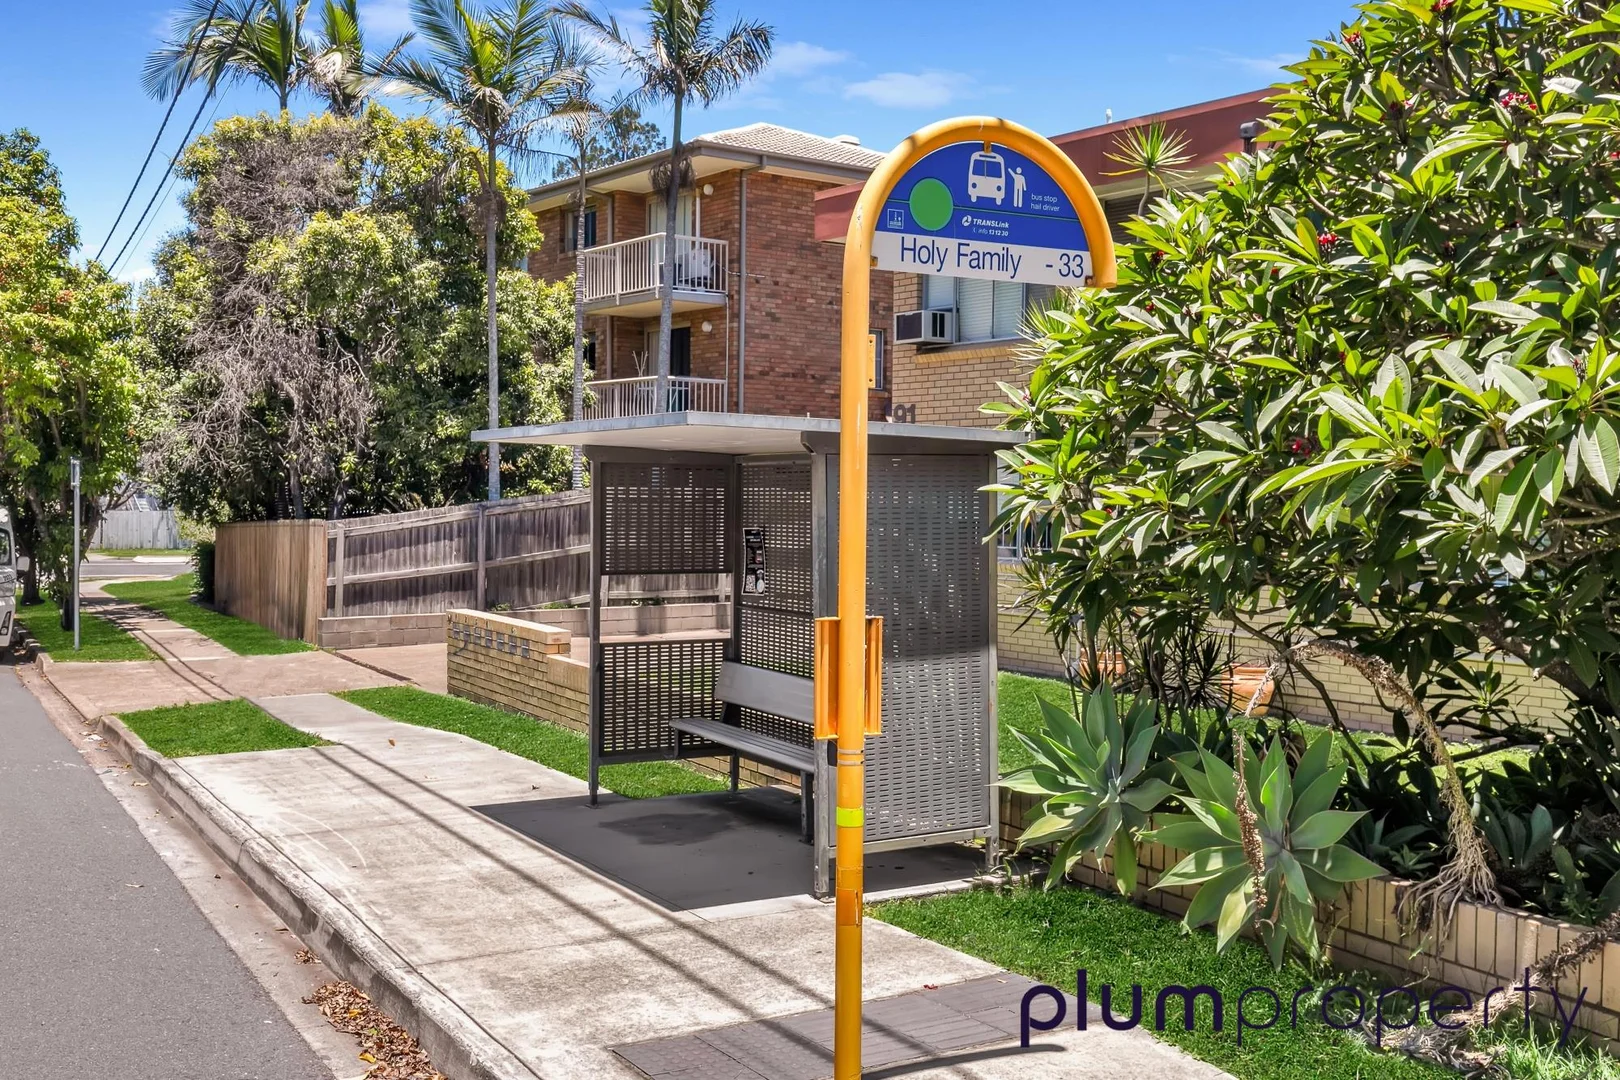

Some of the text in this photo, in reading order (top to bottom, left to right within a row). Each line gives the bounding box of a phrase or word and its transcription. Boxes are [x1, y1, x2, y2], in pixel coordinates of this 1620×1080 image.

[1031, 193, 1058, 203] bus stop
[1030, 202, 1060, 212] hail driver
[901, 236, 949, 273] Holy
[957, 242, 1022, 280] Family
